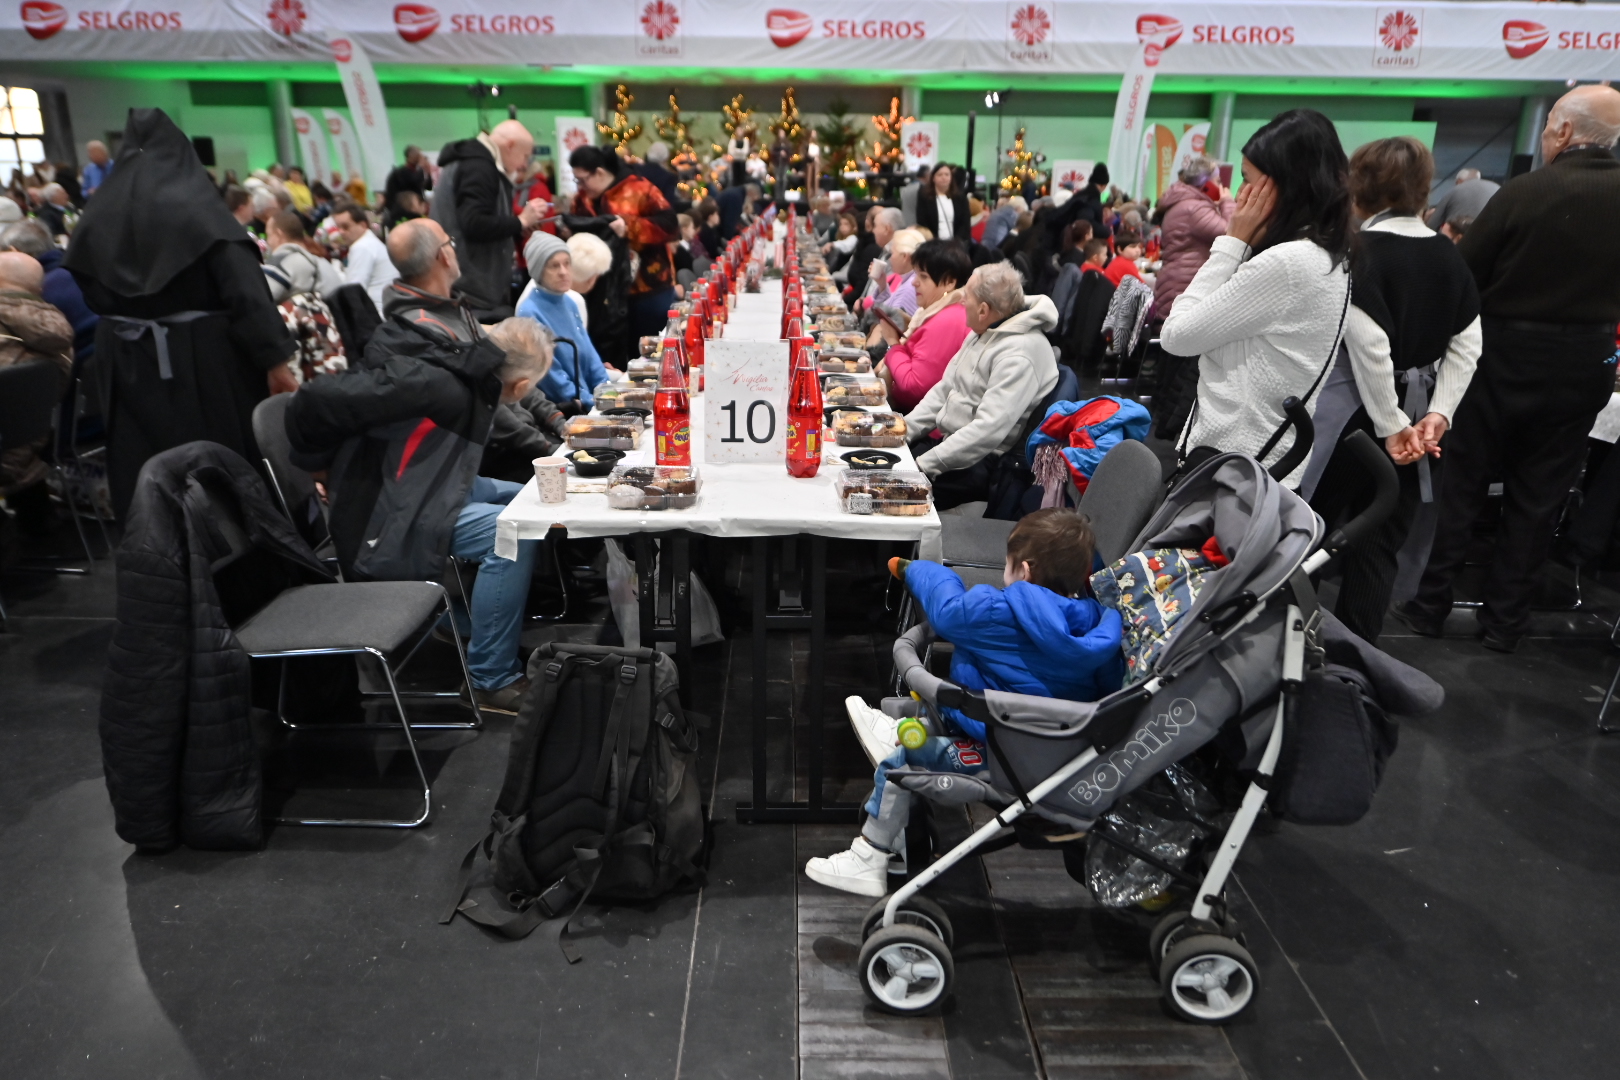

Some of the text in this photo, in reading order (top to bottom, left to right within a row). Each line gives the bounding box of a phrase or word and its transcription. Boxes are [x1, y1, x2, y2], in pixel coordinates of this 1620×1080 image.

[78, 11, 182, 30] SELGROS
[451, 14, 555, 34] SELGROS
[823, 20, 926, 39] SELGROS
[1192, 25, 1295, 44] SELGROS
[640, 45, 679, 54] caritas
[1377, 53, 1415, 65] caritas
[1125, 74, 1144, 130] SELGROS
[720, 399, 776, 444] 10
